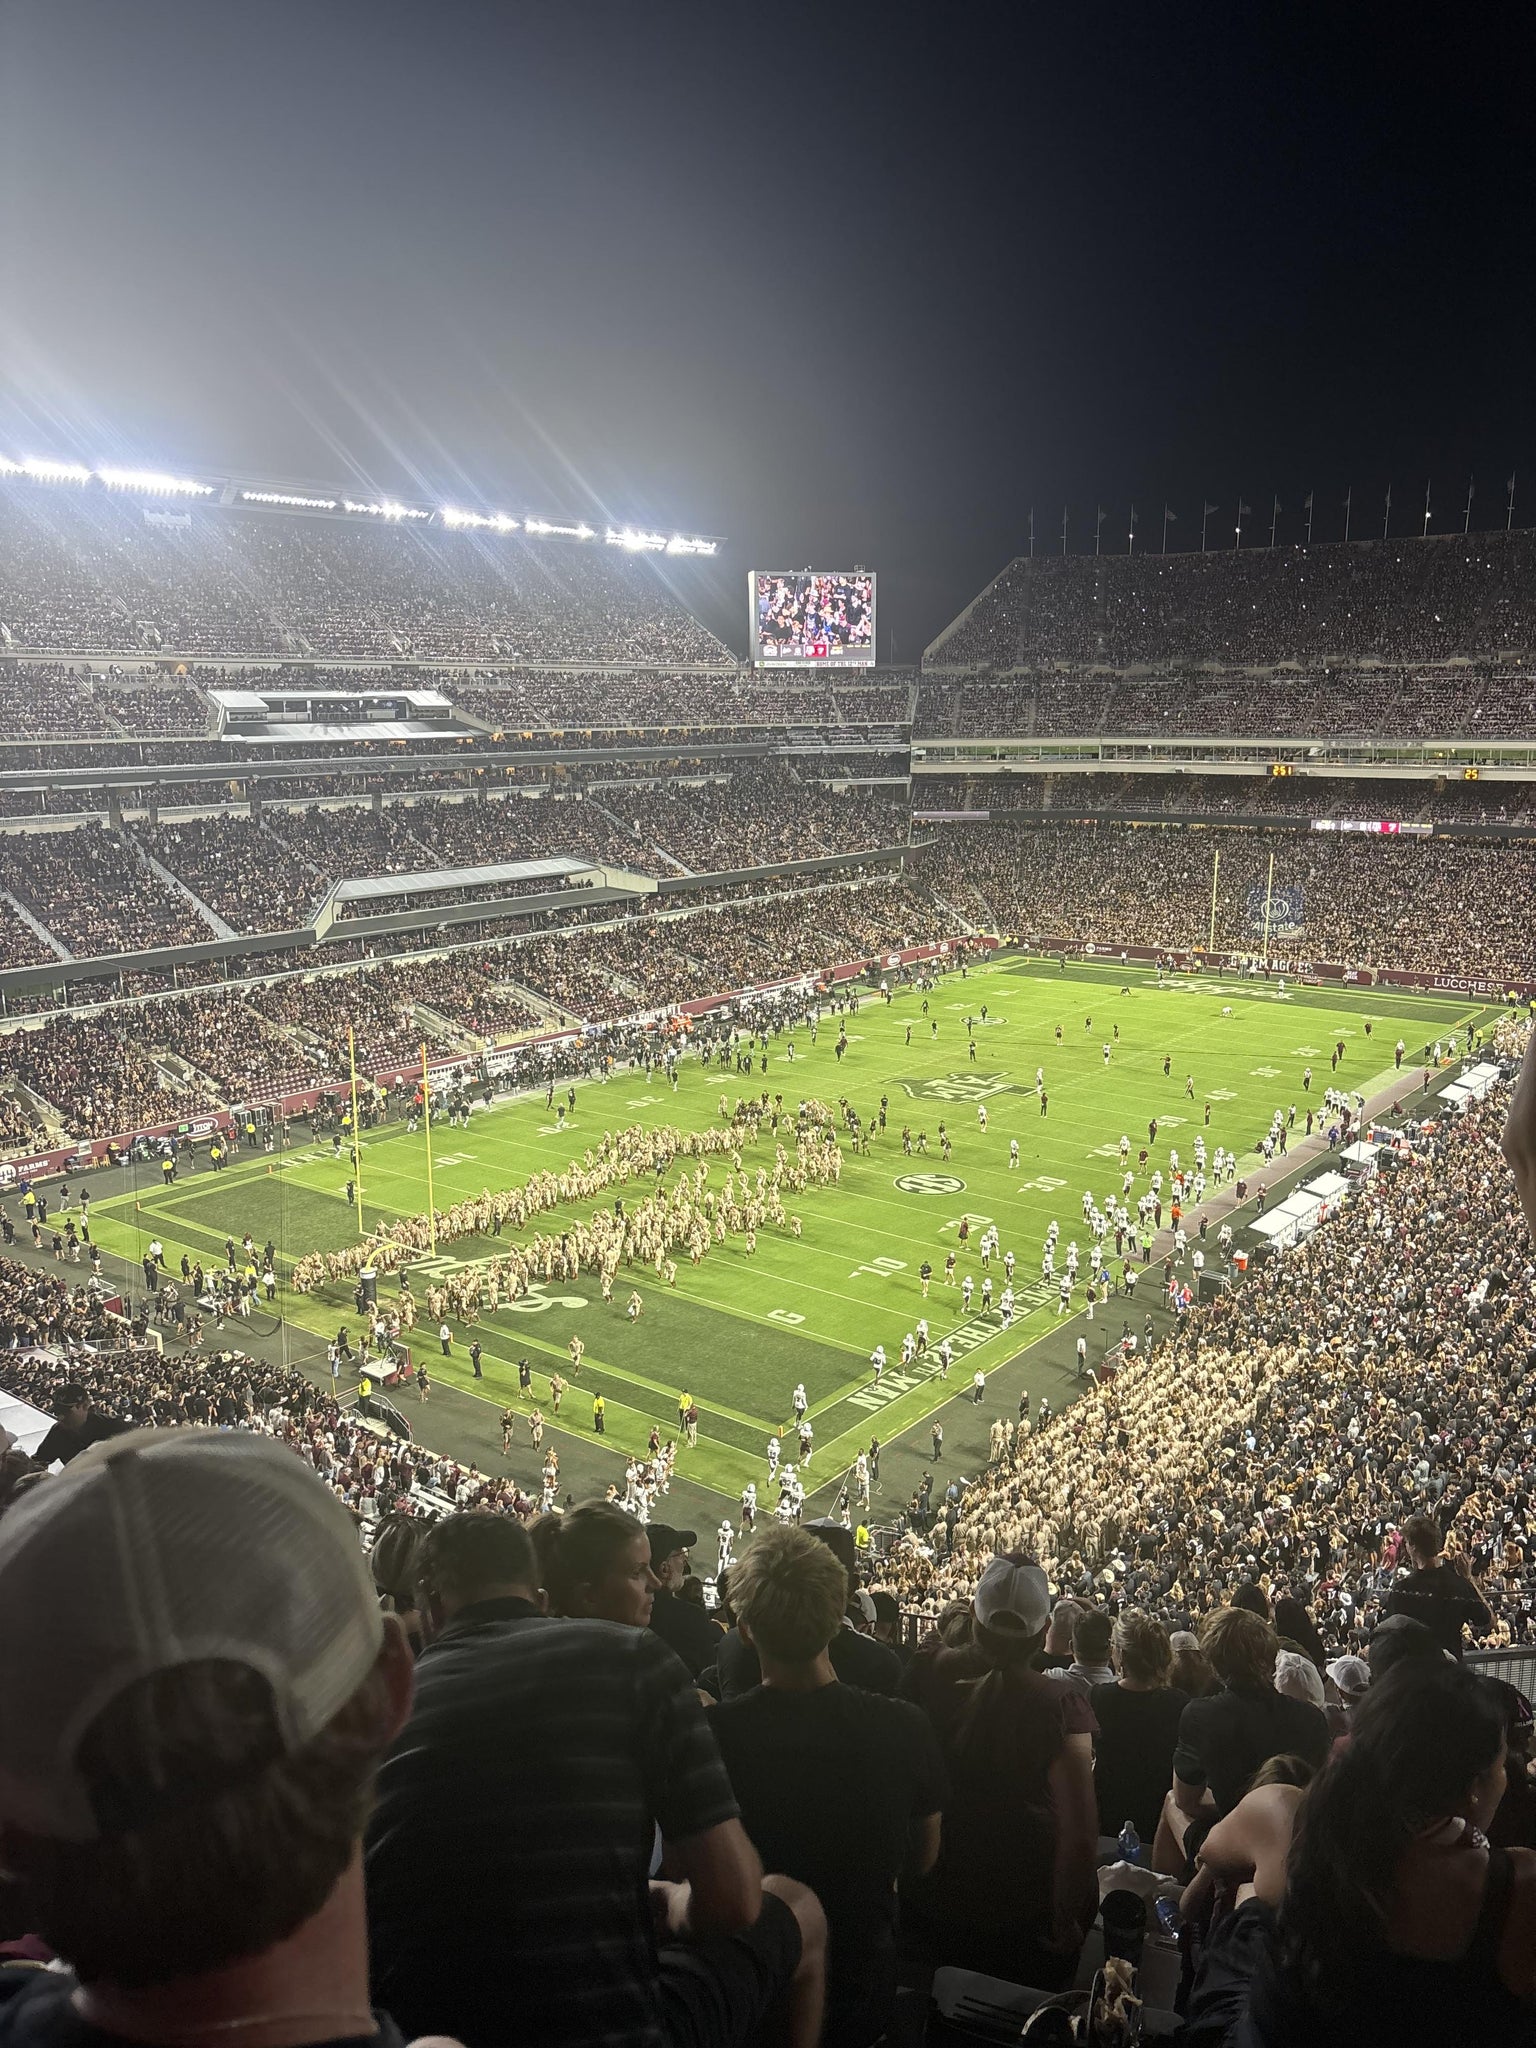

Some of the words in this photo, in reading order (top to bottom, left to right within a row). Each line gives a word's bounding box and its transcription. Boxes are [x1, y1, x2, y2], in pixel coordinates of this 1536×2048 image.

[18, 1160, 48, 1173] FARMS
[858, 1257, 908, 1277] 10
[847, 1371, 921, 1411] MAN
[1504, 1511, 1514, 1524] 12
